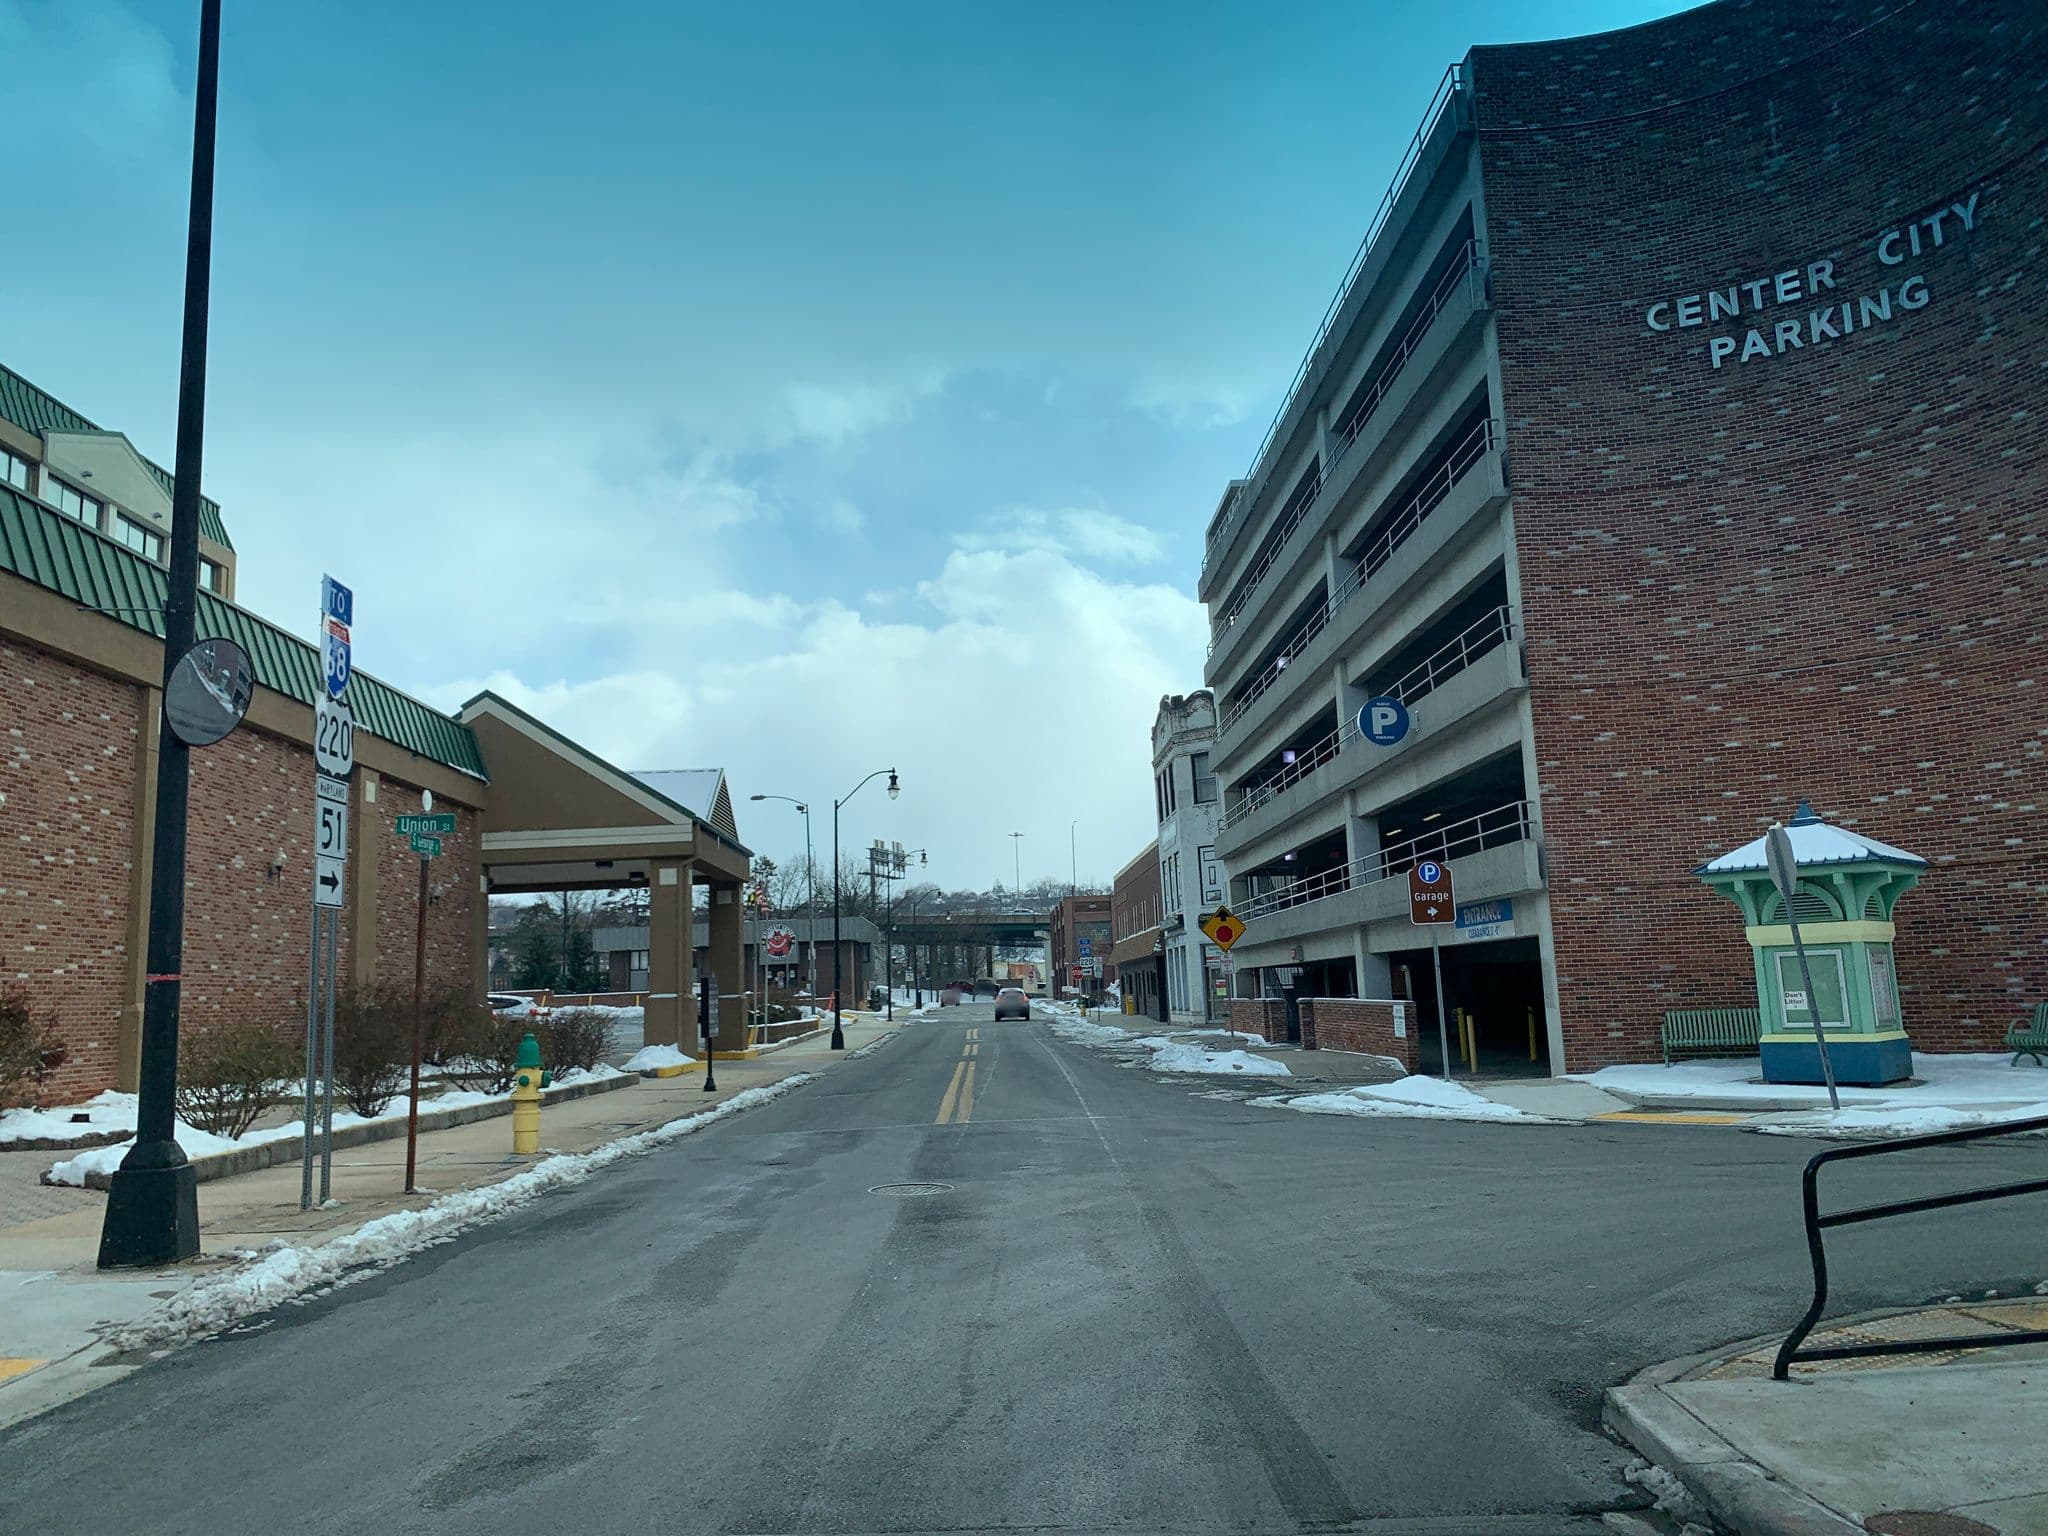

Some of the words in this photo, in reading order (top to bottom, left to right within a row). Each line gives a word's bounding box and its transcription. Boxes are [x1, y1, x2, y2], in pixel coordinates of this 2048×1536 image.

[1646, 259, 1837, 332] CENTER
[1877, 191, 1980, 265] CITY
[1709, 275, 1930, 369] PARKING
[330, 587, 346, 614] TO
[327, 645, 347, 682] 68
[1371, 706, 1398, 735] P
[318, 711, 350, 762] 220
[320, 781, 346, 800] MARYLAND
[321, 807, 342, 853] 51
[401, 818, 437, 832] Union
[1424, 864, 1437, 881] P
[1414, 892, 1449, 903] Garage
[1080, 957, 1093, 967] 220
